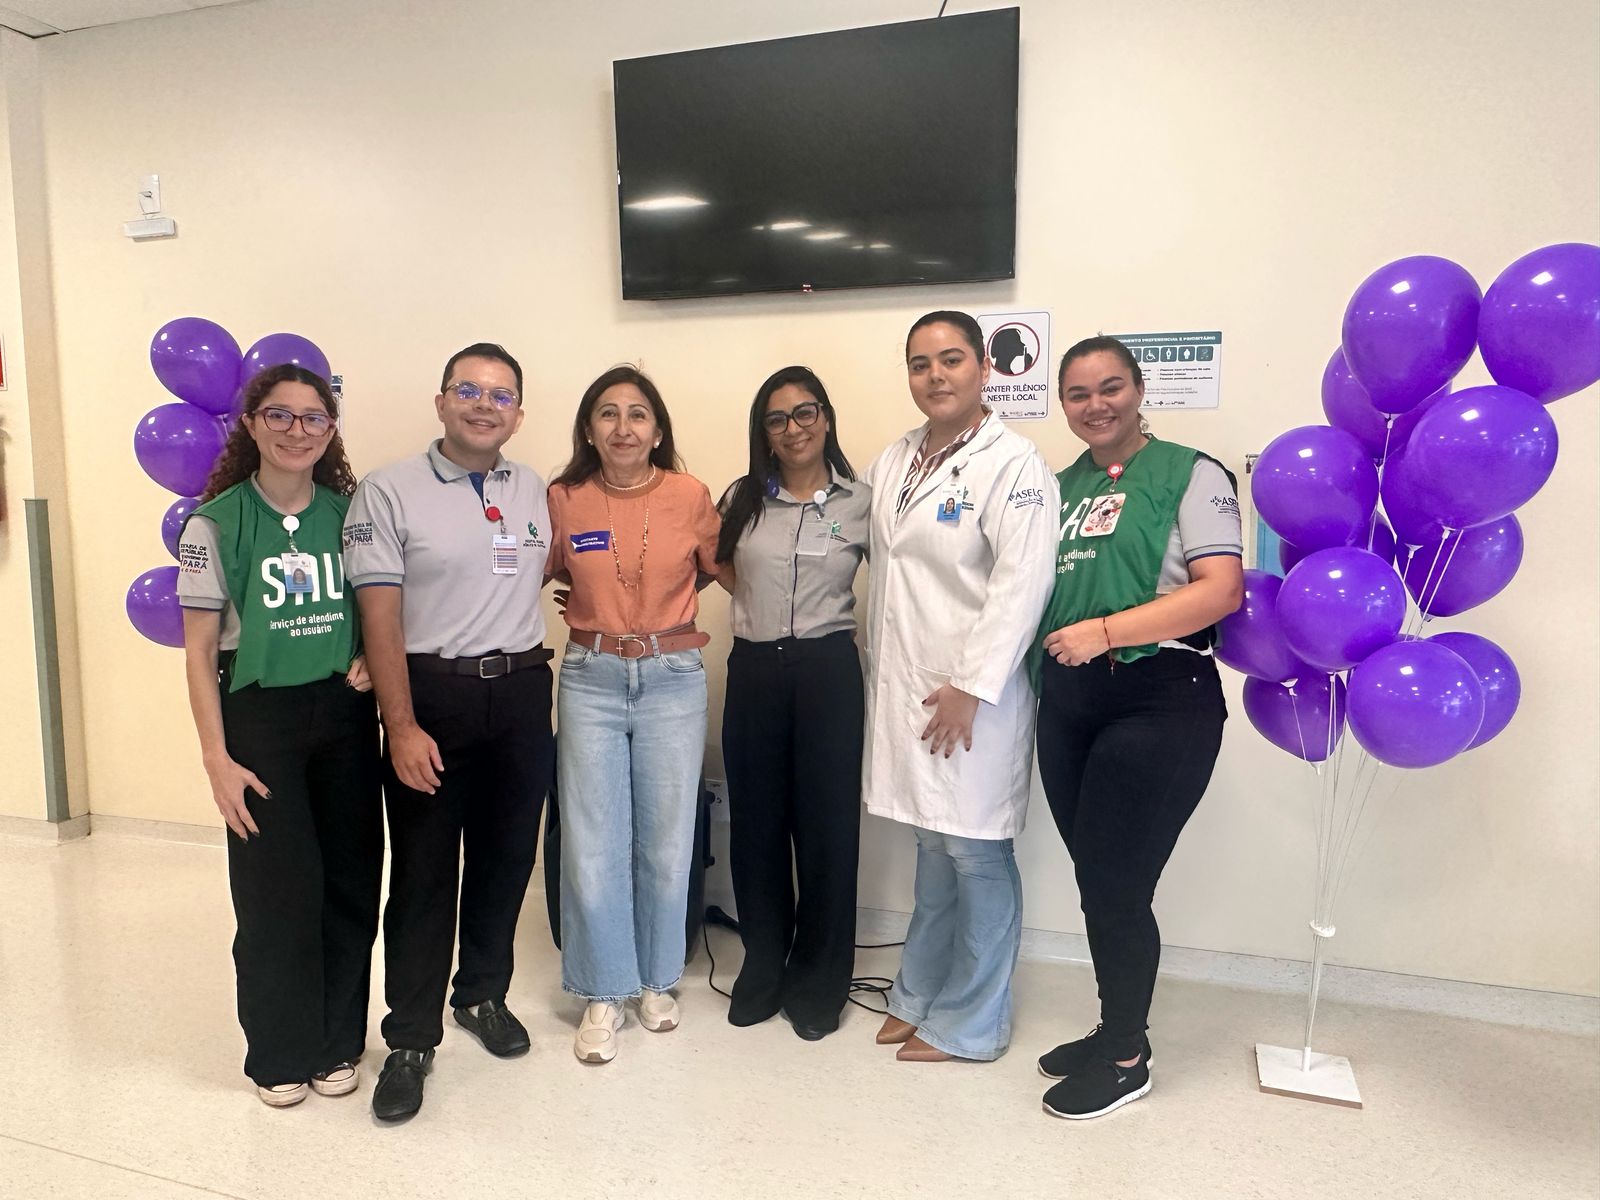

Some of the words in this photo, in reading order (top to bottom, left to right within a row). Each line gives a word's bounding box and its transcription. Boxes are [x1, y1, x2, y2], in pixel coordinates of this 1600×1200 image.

[1012, 383, 1047, 393] SILÊNCIO
[987, 394, 1010, 402] NESTE
[1012, 393, 1038, 401] LOCAL
[296, 615, 307, 625] de
[290, 629, 301, 637] ao
[302, 623, 332, 636] usuário
